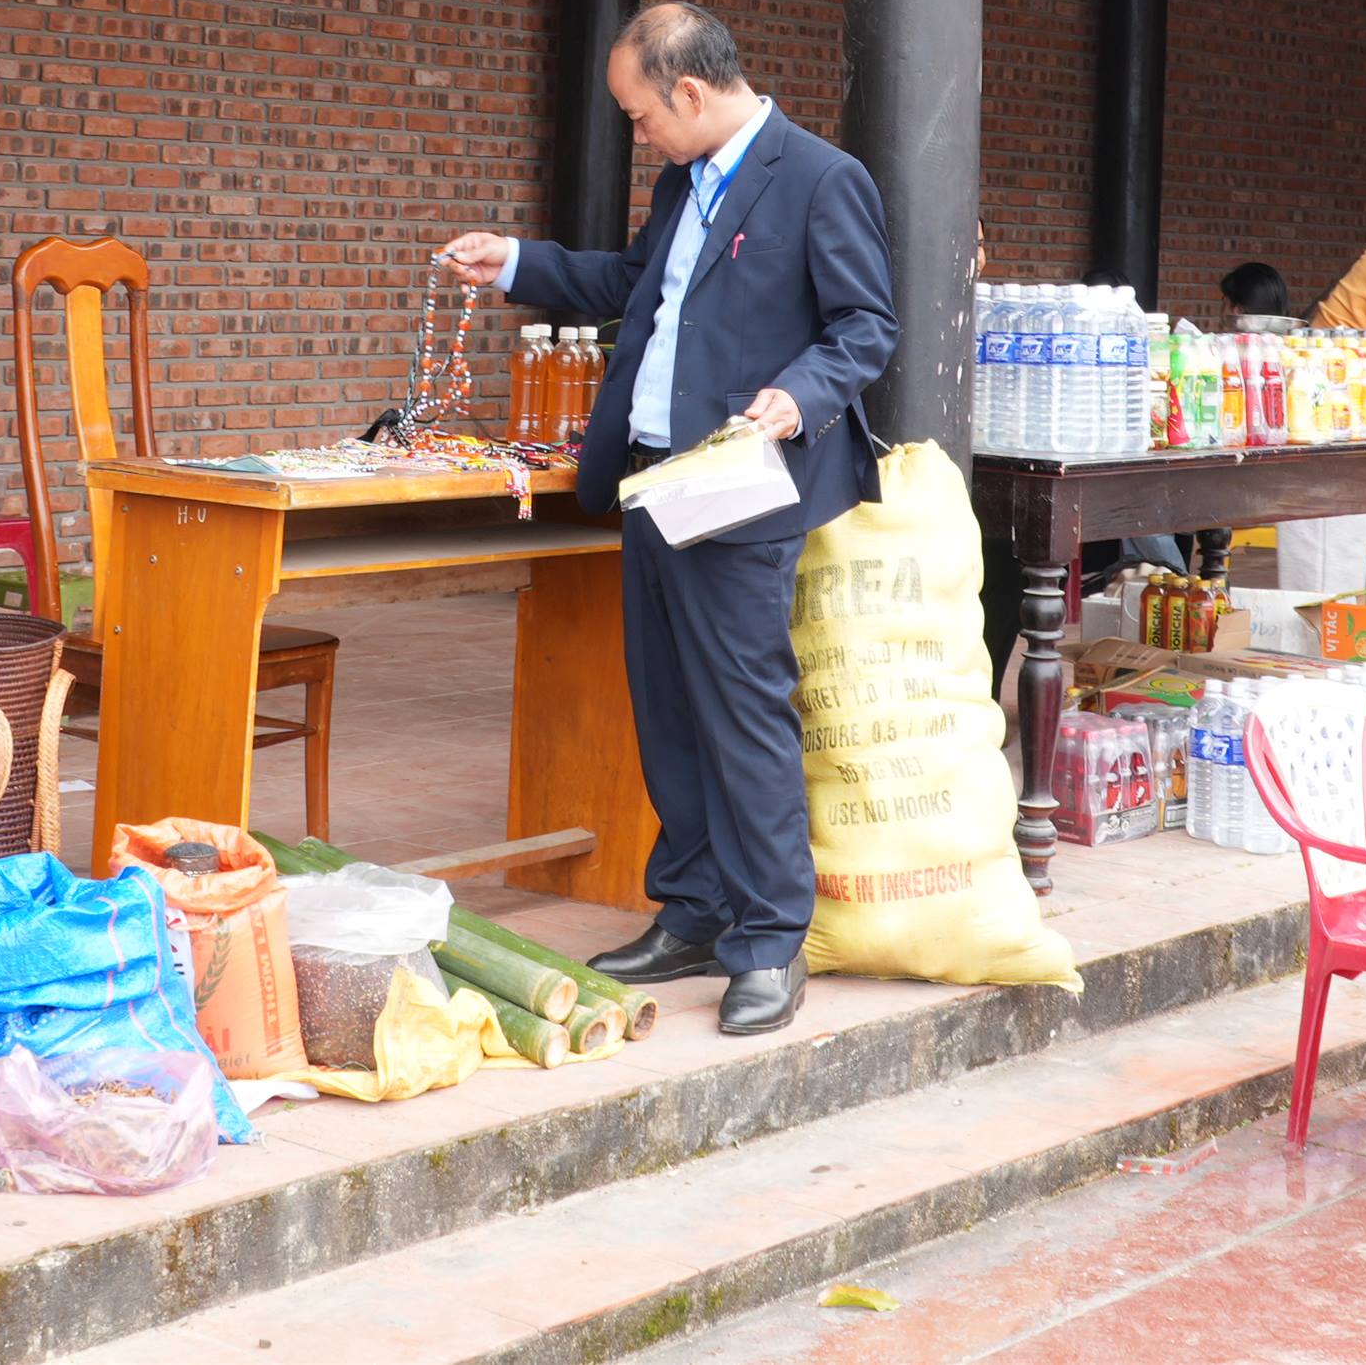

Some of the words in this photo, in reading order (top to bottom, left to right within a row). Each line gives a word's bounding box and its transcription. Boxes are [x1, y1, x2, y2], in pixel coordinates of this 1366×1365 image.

[1152, 602, 1163, 647] ONCHA
[871, 720, 897, 745] 0.5
[829, 802, 859, 826] USE
[863, 799, 888, 823] NO
[893, 790, 952, 821] HOOKS
[855, 874, 875, 903] IN
